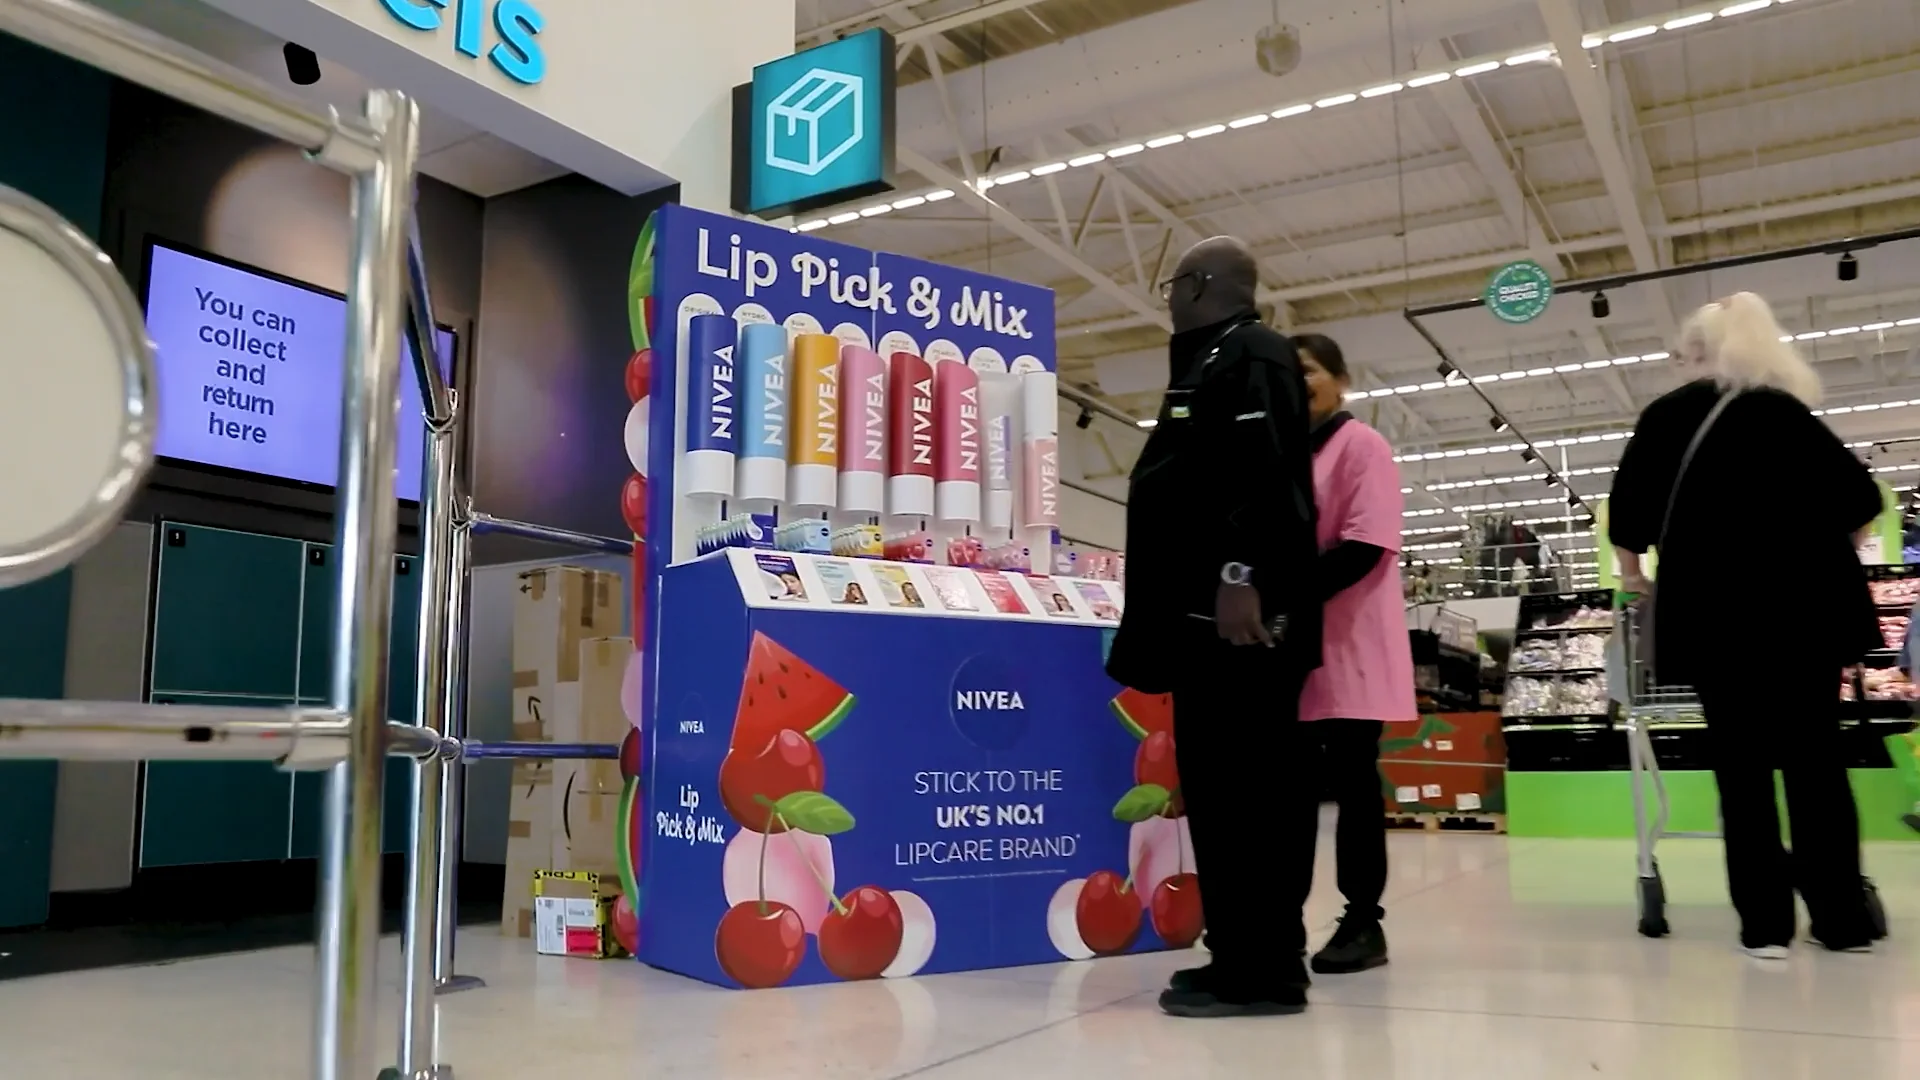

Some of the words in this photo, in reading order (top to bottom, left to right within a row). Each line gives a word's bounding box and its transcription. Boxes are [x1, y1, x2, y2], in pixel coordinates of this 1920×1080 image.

[697, 227, 778, 297] Lip
[791, 251, 898, 315] Pick
[907, 275, 941, 331] &
[950, 284, 1034, 340] Mix
[194, 286, 244, 321] You
[252, 308, 296, 335] can
[199, 325, 288, 362] collect
[216, 359, 266, 386] and
[203, 384, 275, 416] return
[711, 345, 734, 440] NIVEA
[763, 354, 785, 446] NIVEA
[817, 363, 837, 454] NIVEA
[208, 411, 267, 444] here
[864, 373, 884, 461] NIVEA
[912, 378, 932, 465] NIVEA
[960, 386, 978, 471] NIVEA
[988, 415, 1005, 481] NIVEA
[1042, 450, 1058, 516] NIVEA
[956, 690, 1025, 710] NIVEA
[680, 720, 705, 734] NIVEA
[680, 783, 700, 815] Lip
[914, 771, 980, 795] STICK
[983, 769, 1016, 792] TO
[1019, 769, 1063, 792] THE
[656, 810, 683, 840] Pick
[684, 814, 696, 847] &
[697, 816, 726, 844] Mix
[936, 804, 991, 829] UK'S
[996, 803, 1045, 826] NO.1
[895, 838, 994, 866] LIPCARE
